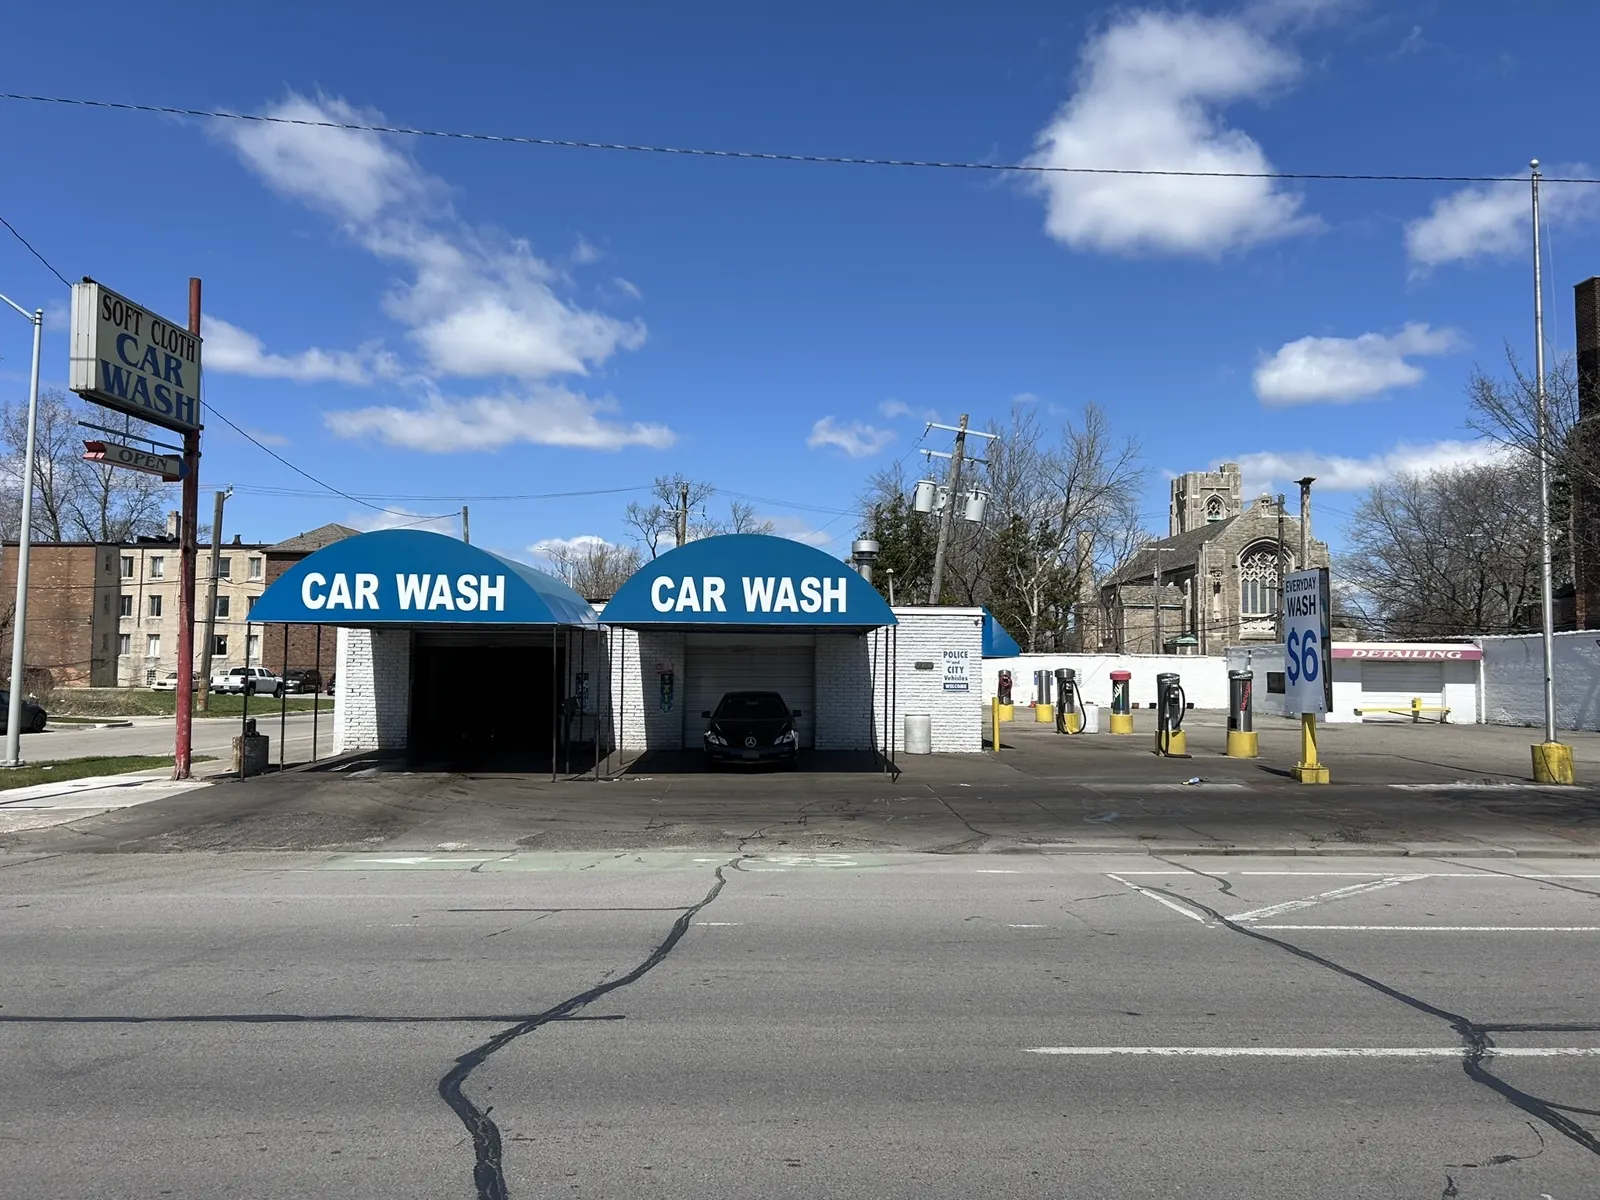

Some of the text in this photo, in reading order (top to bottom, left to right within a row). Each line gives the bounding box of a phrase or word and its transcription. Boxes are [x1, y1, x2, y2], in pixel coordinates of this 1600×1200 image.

[102, 294, 195, 363] SOFT CLOTH
[116, 332, 184, 389] CAR
[99, 358, 195, 426] WASH
[118, 449, 169, 472] OPEN
[301, 572, 505, 612] CAR WASH
[651, 575, 847, 613] CAR WASH
[1285, 576, 1317, 594] EVERYDAY
[1287, 594, 1317, 618] WASH
[947, 666, 965, 674] CITY
[1287, 627, 1319, 686] $6
[1350, 649, 1462, 659] DETAILING
